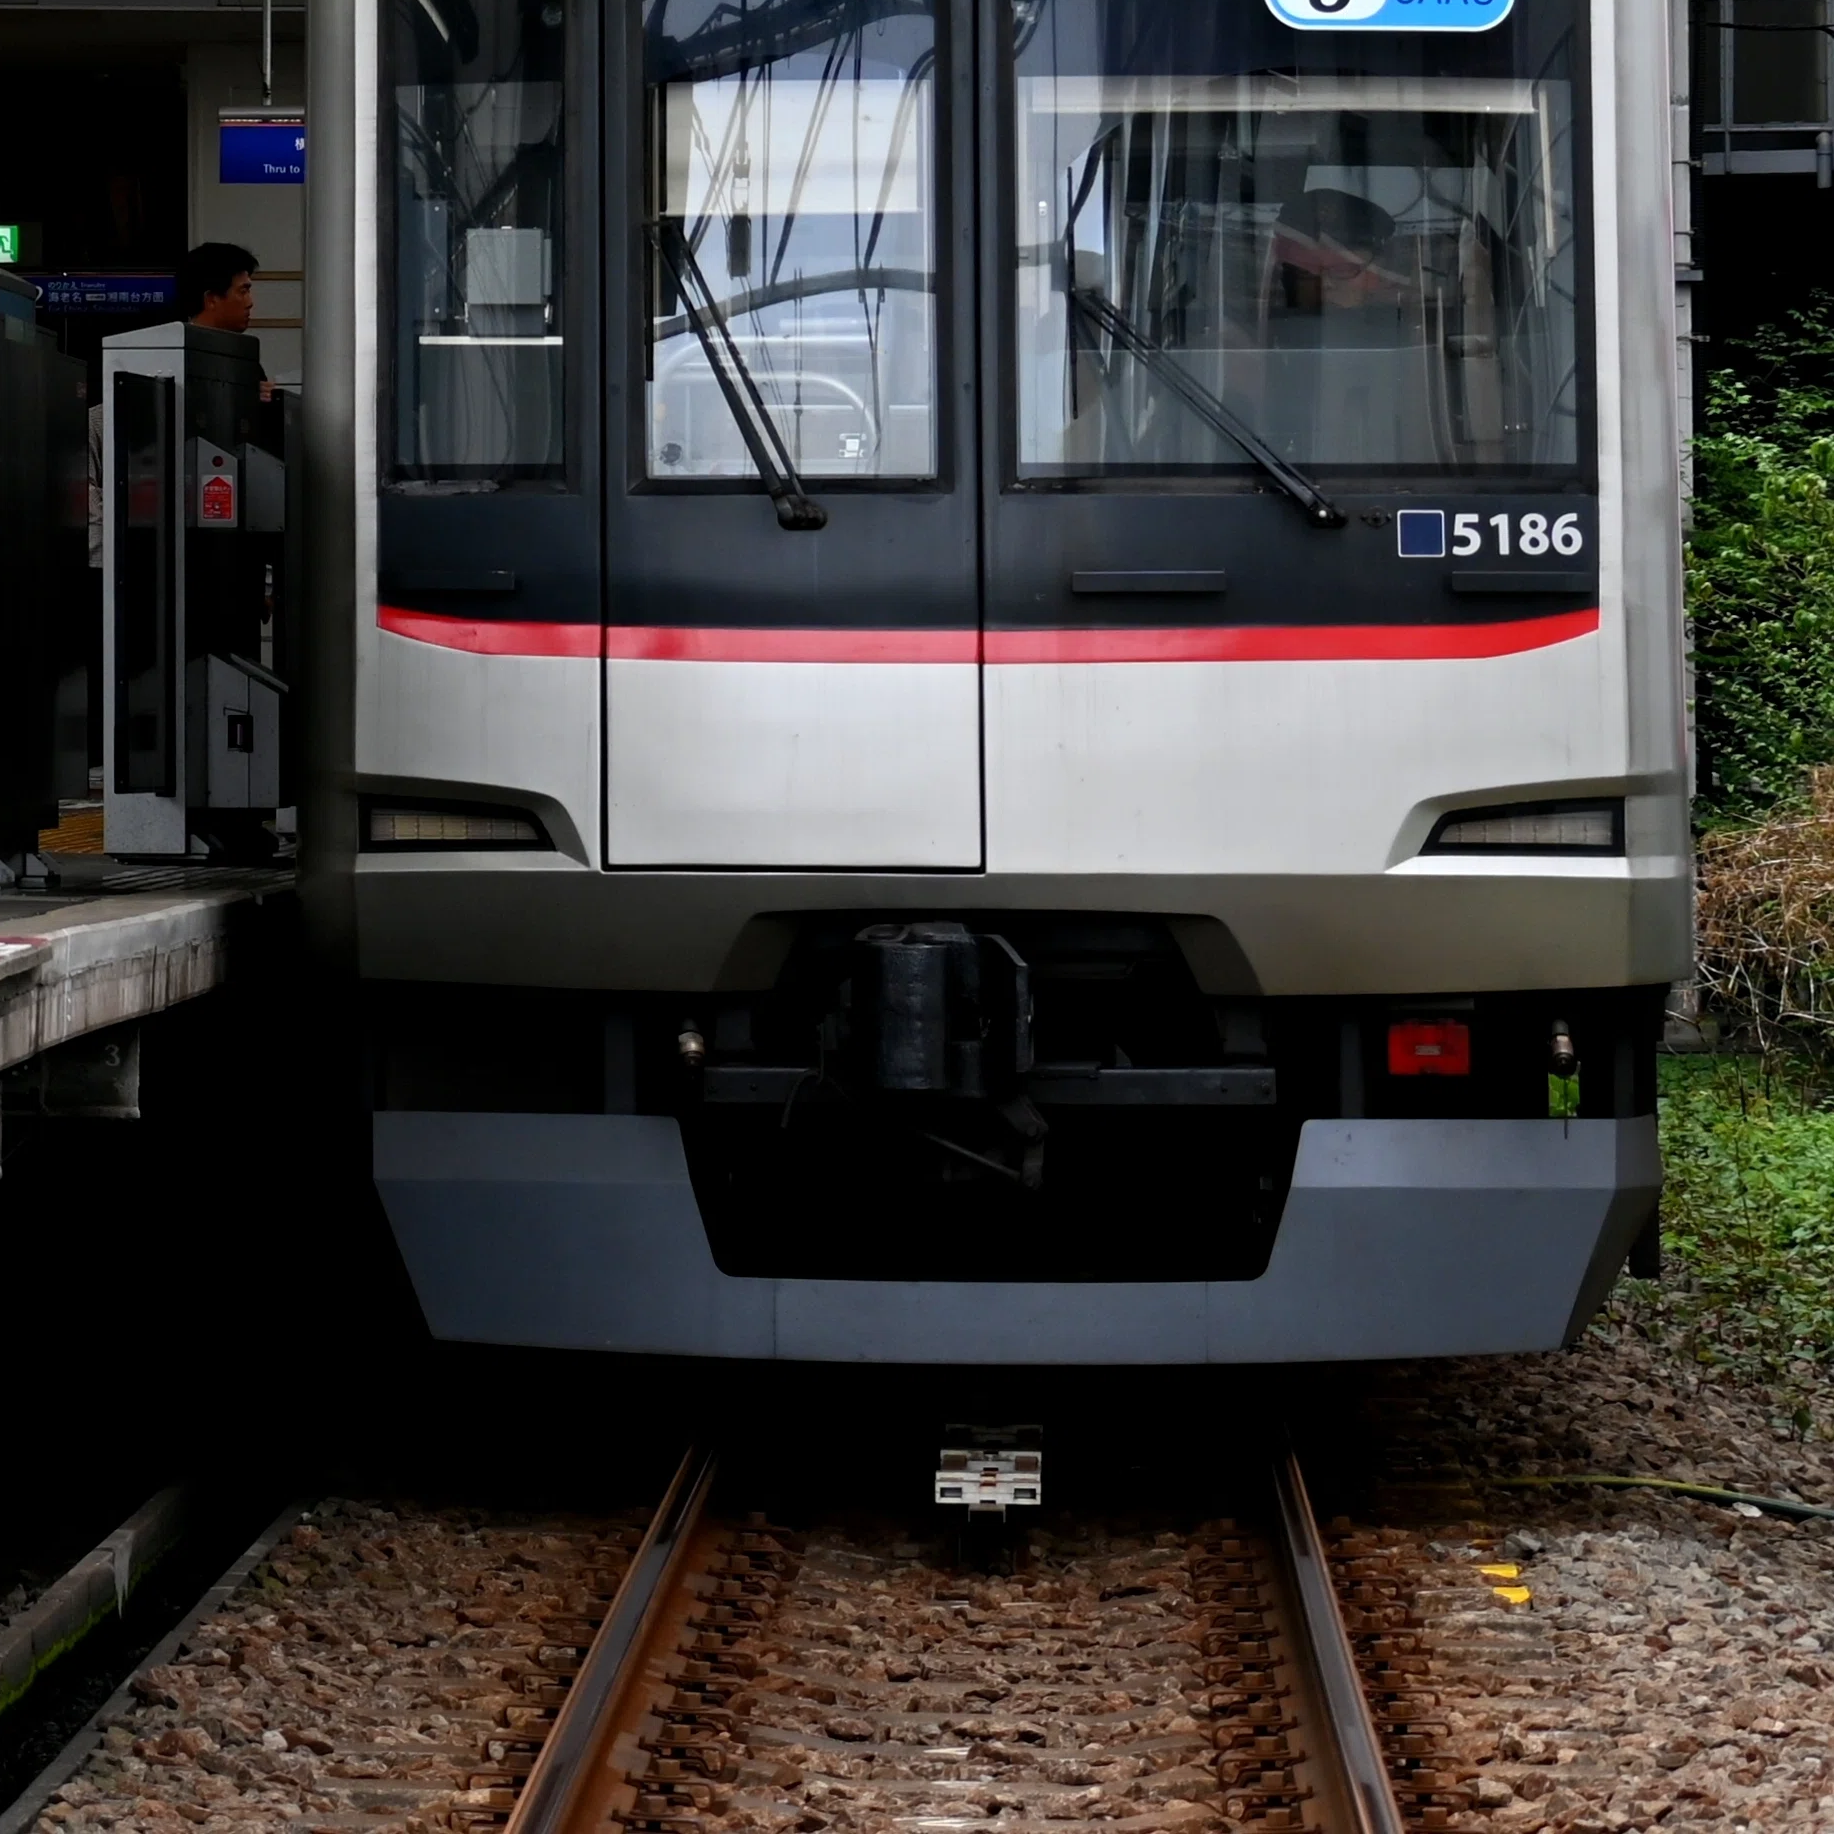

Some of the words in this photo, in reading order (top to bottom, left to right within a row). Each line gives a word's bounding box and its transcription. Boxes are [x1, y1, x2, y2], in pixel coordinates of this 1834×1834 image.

[263, 164, 287, 174] Thru
[289, 164, 301, 174] to
[1452, 512, 1583, 556] 5186
